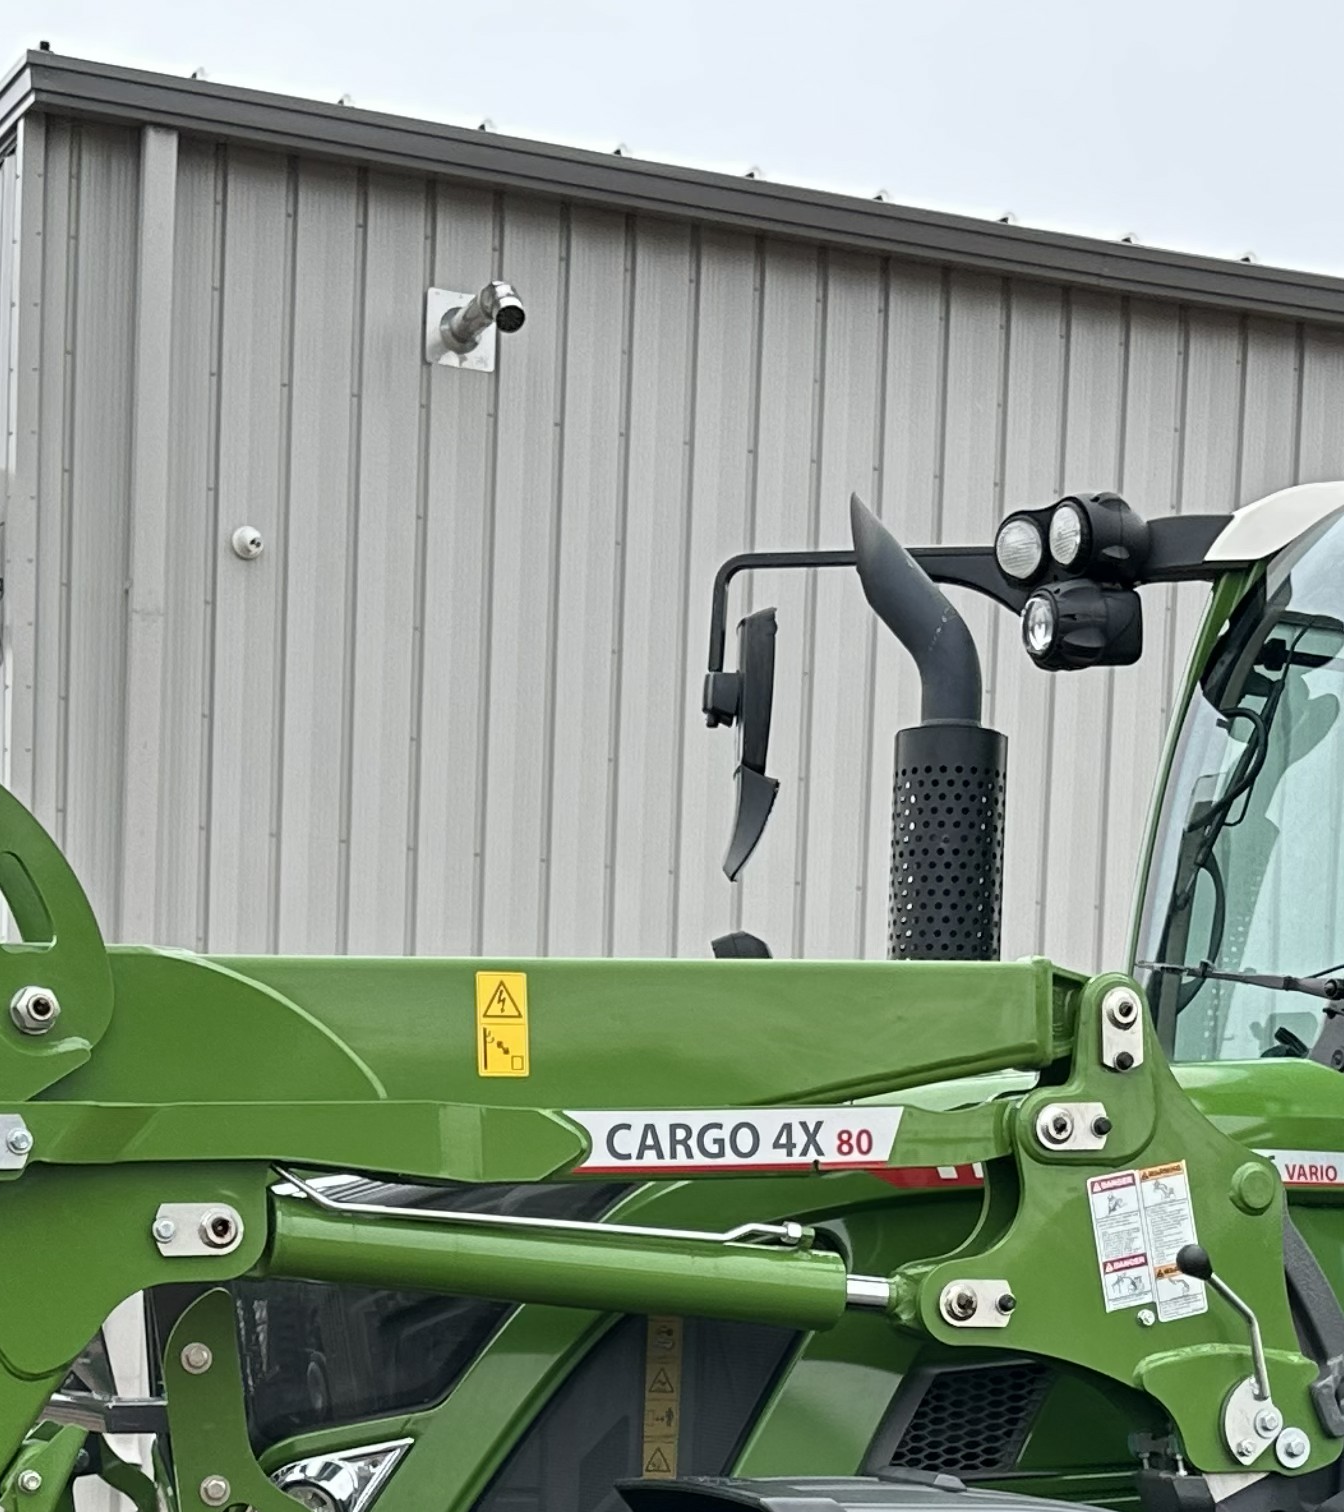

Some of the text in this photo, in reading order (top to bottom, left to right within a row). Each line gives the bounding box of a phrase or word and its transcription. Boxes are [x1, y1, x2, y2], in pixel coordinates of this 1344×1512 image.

[606, 1120, 873, 1161] CARGO 4X 80
[1285, 1163, 1338, 1182] VARIO
